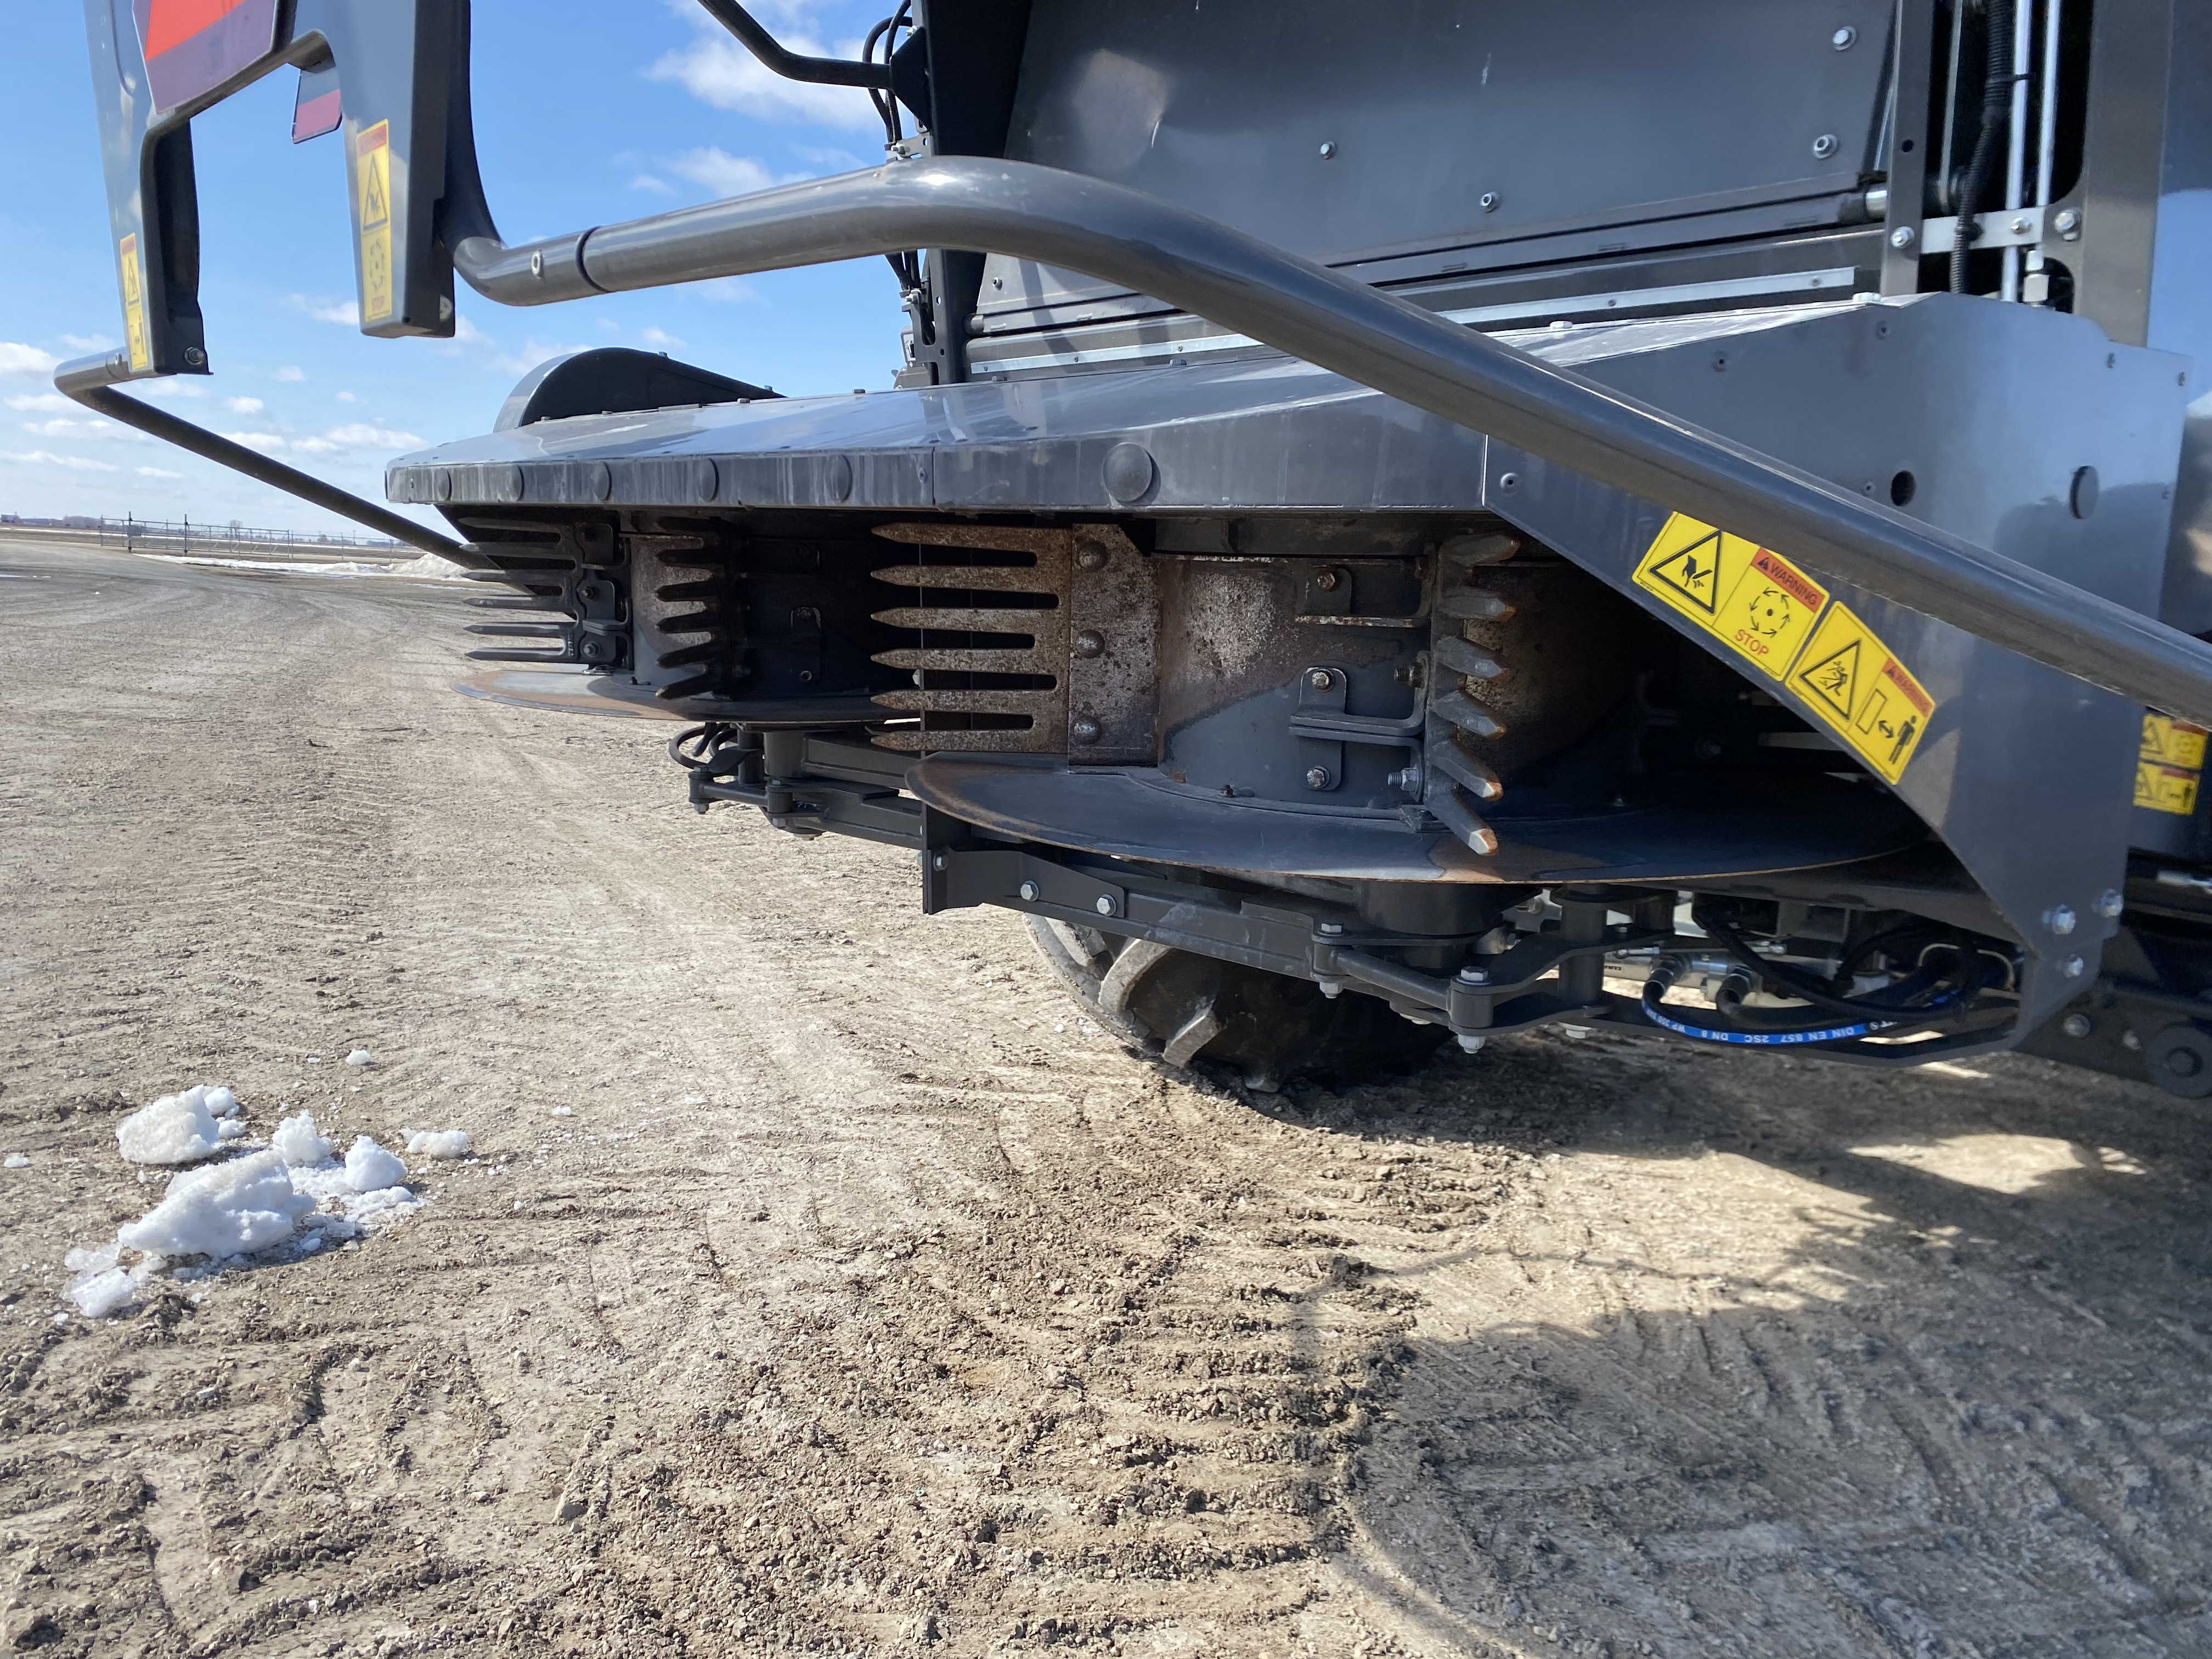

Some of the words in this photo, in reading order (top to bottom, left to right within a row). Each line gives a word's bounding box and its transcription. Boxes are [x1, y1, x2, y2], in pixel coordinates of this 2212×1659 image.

[1770, 562, 1818, 606] WARNING
[1735, 629, 1769, 656] STOP
[1672, 1024, 1686, 1033] WP
[1832, 1026, 1854, 1038] DIN
[1702, 1030, 1708, 1038] 8
[1712, 1031, 1728, 1041] DN
[1744, 1034, 1769, 1043] 2SC
[1780, 1033, 1803, 1043] 857
[1808, 1030, 1827, 1040] EN
